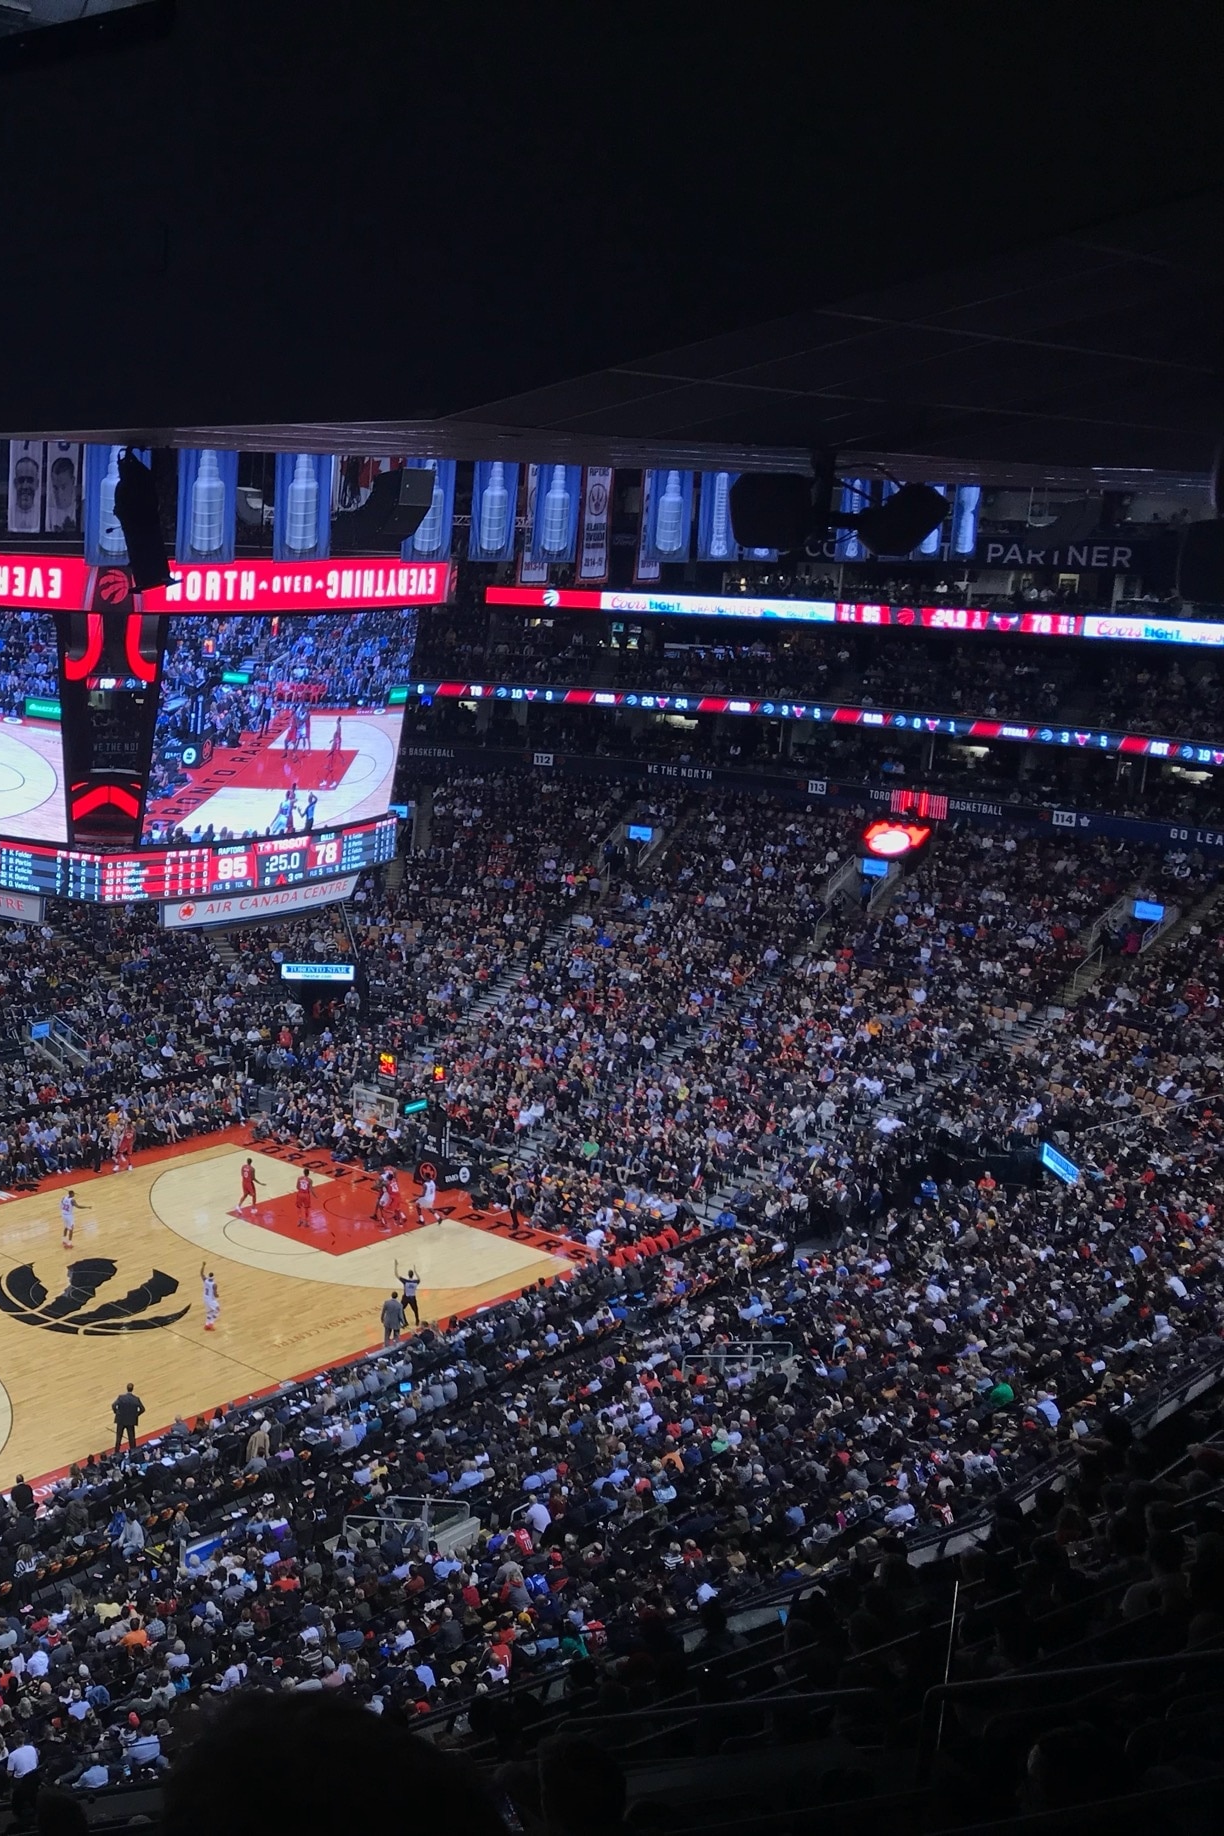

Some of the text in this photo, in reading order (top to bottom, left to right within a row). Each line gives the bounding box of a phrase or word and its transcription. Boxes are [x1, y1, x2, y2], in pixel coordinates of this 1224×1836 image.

[165, 568, 436, 602] NORTH OVER EVERYTHING
[610, 595, 646, 610] Coors
[1097, 620, 1142, 638] Coors
[469, 685, 483, 697] TO
[511, 688, 522, 700] 10
[641, 695, 688, 709] 26 24
[781, 705, 821, 719] 3 5
[913, 717, 921, 729] 0
[1061, 732, 1107, 747] 3 5
[408, 746, 455, 759] BASKETBALL
[534, 754, 553, 765] 112
[1197, 749, 1211, 762] 19
[660, 765, 677, 777] THE
[680, 767, 713, 781] NORTH
[808, 781, 826, 795] 113
[949, 801, 1003, 817] BASKETBALL
[1053, 811, 1074, 826] 114
[1169, 827, 1189, 841] GO
[218, 846, 246, 856] RAPTORS
[273, 836, 308, 852] TISSOT
[315, 842, 338, 866] 78
[218, 856, 248, 880] 95
[265, 852, 300, 874] :25.0
[225, 882, 231, 890] 5
[264, 873, 294, 886] 8 3
[204, 879, 348, 916] AIR CANADA CENTRE
[290, 966, 347, 974] TORONTO STAR
[380, 1060, 395, 1075] 24
